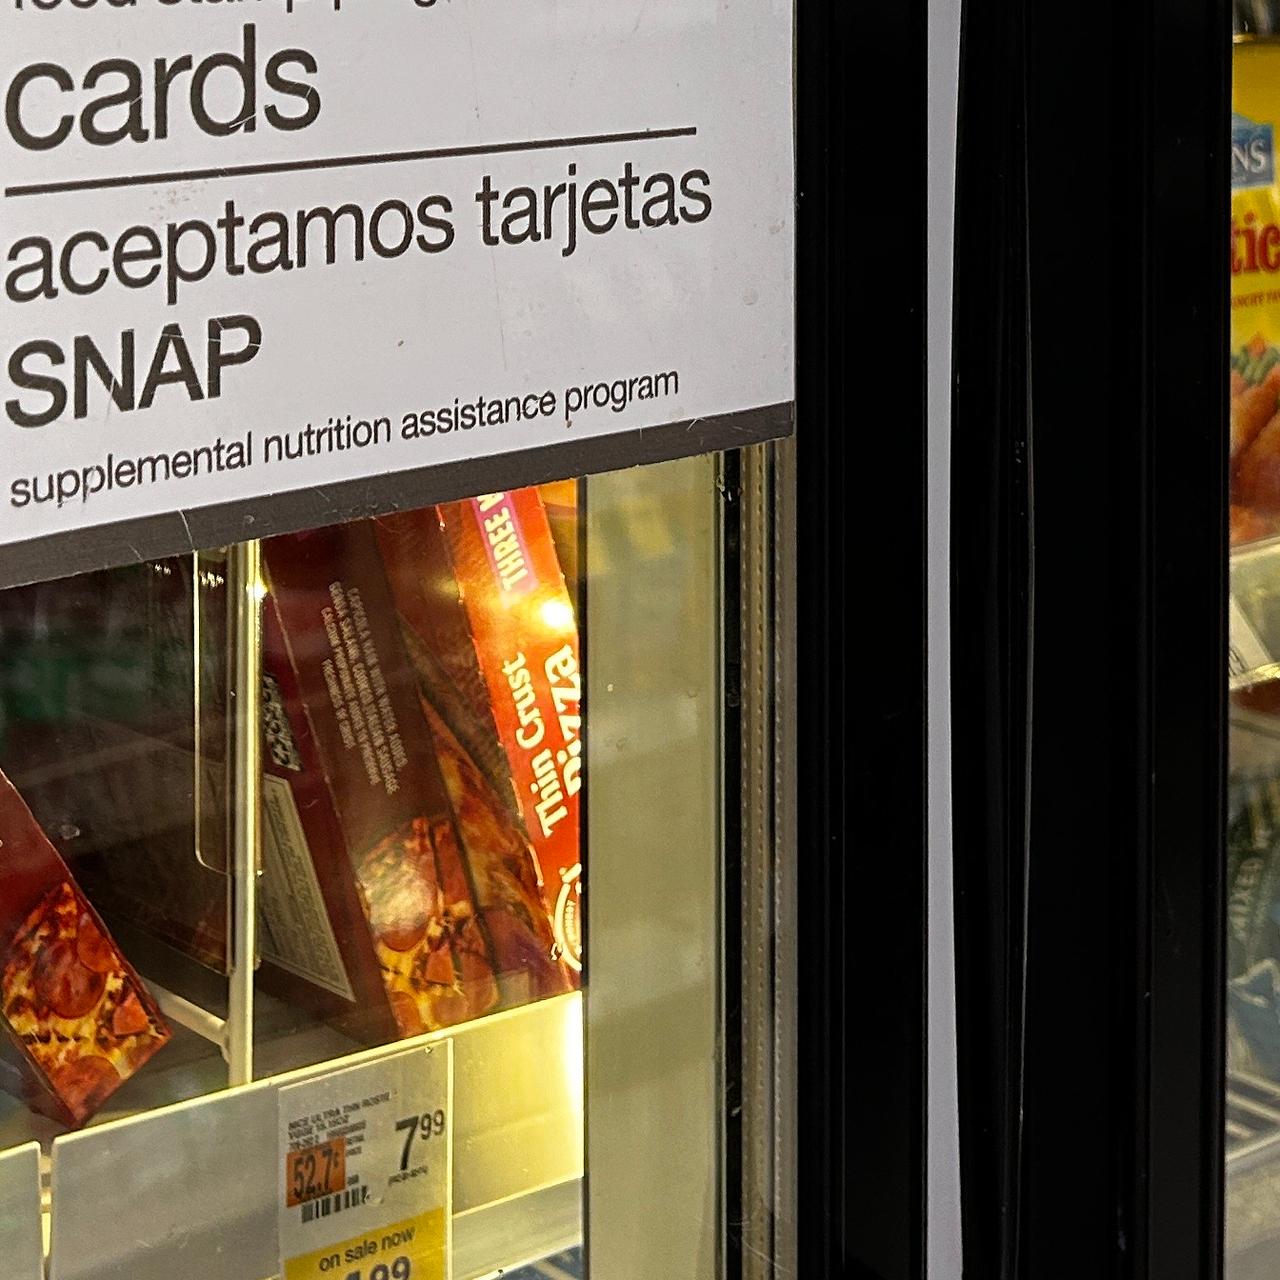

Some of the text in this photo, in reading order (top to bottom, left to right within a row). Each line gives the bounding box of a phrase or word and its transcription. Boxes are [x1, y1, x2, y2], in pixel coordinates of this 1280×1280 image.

[4, 23, 322, 150] cards
[3, 161, 713, 305] aceptamos tarjetas
[4, 313, 263, 429] SNAP
[9, 367, 680, 508] supplemental nutrition assistance program
[484, 507, 529, 592] THREE
[502, 652, 567, 836] Thin Crust
[320, 1227, 416, 1272] on sale now
